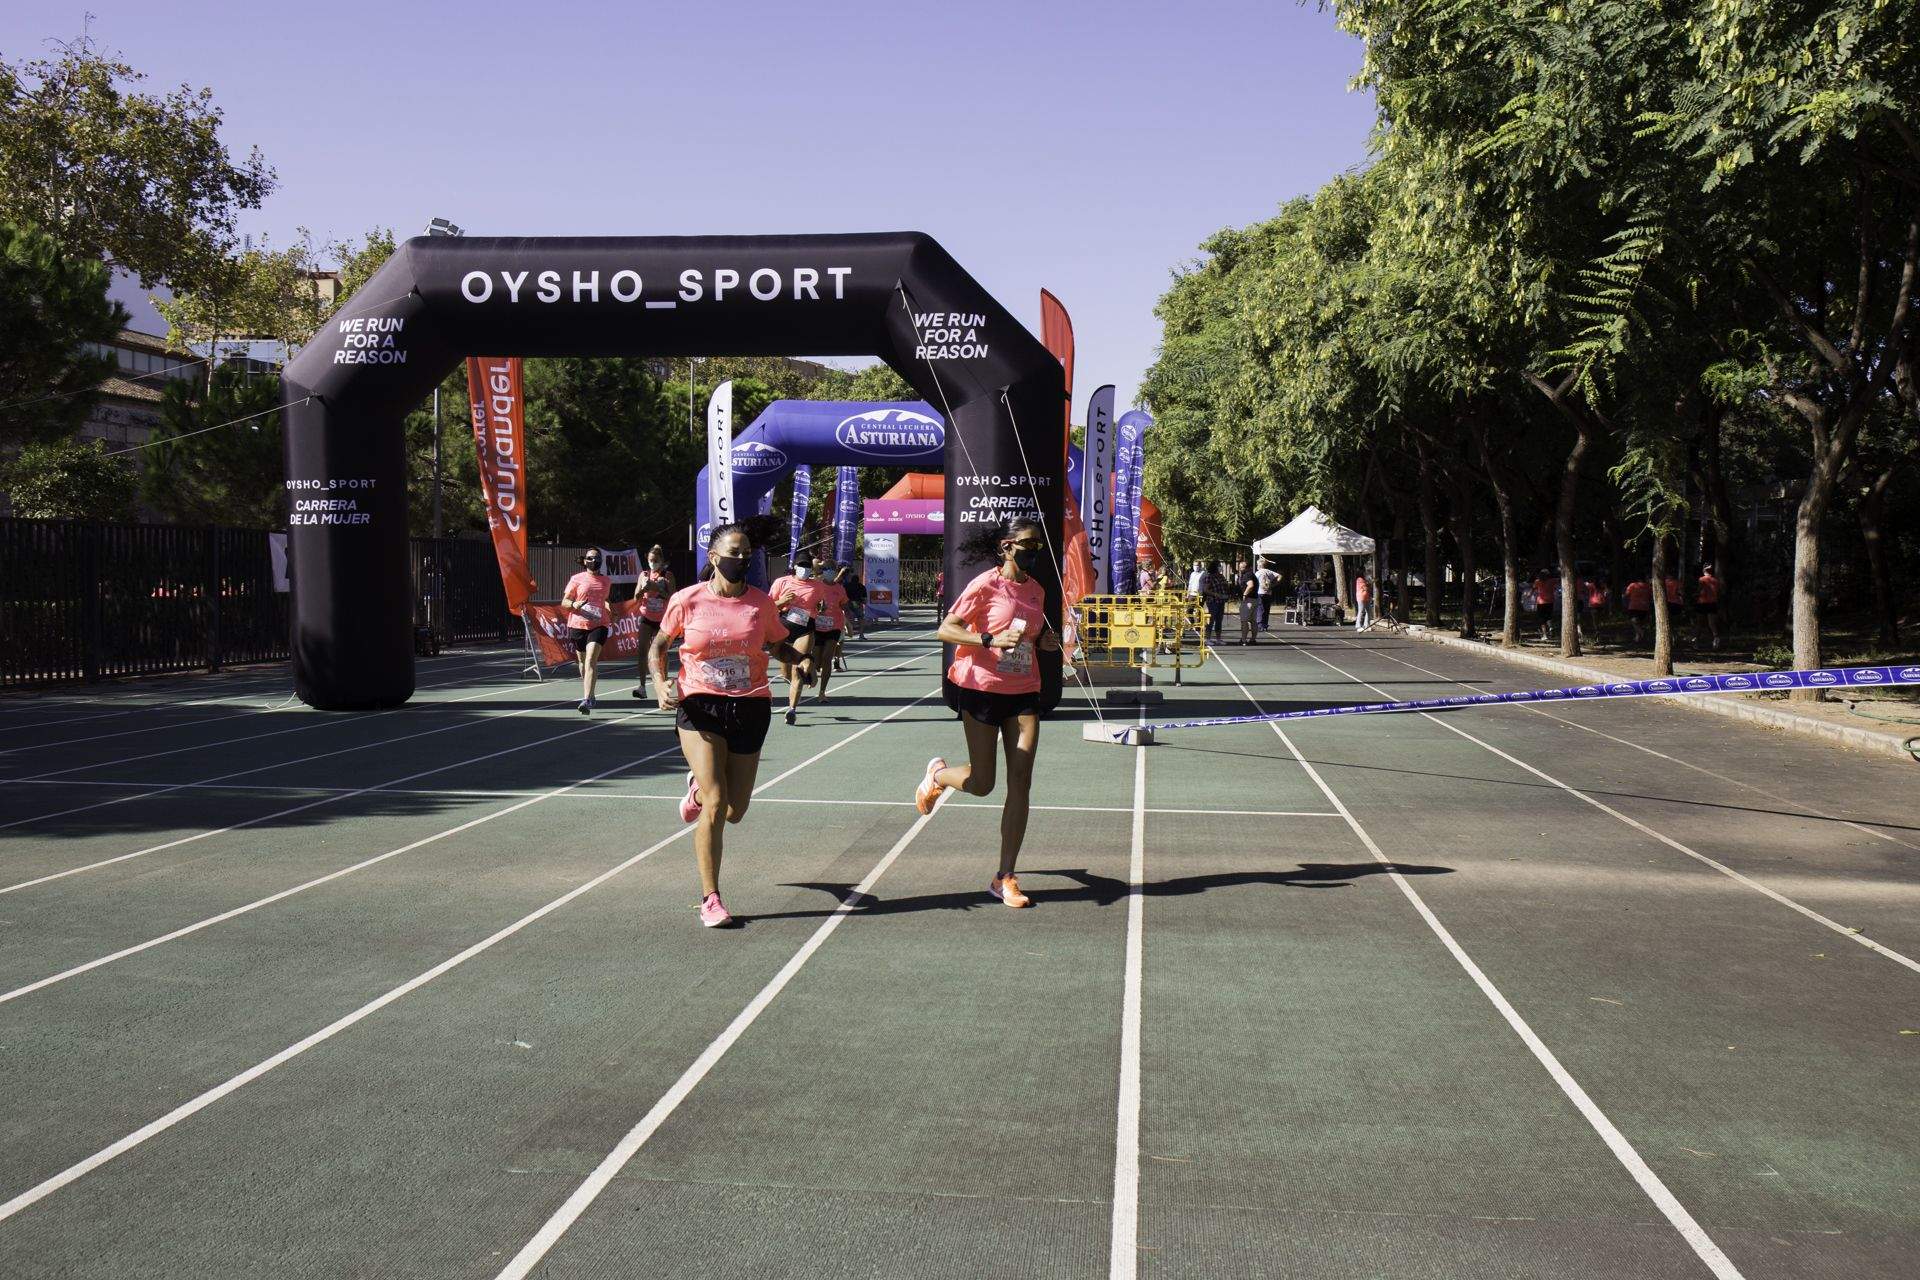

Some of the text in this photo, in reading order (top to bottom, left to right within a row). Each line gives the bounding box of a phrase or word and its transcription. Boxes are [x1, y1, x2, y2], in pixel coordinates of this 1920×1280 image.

[461, 267, 852, 309] OYSHO_SPORT
[339, 318, 404, 332] WE RUN
[914, 313, 986, 327] WE RUN
[343, 333, 395, 348] FOR A
[924, 329, 977, 343] FOR A
[333, 350, 407, 364] REASON
[915, 344, 988, 360] REASON
[861, 423, 896, 431] CENTRAL
[844, 424, 939, 446] ASTURIANA
[732, 457, 782, 467] STURIANA
[286, 480, 376, 491] OYSHO_SPORT
[956, 476, 1051, 487] OYSHO_SPORT
[296, 500, 357, 511] CARRERA
[969, 496, 1035, 508] CARRERA
[290, 514, 371, 525] DE LA MUJER
[960, 511, 977, 523] DE
[979, 511, 996, 523] LA
[711, 629, 728, 637] WE
